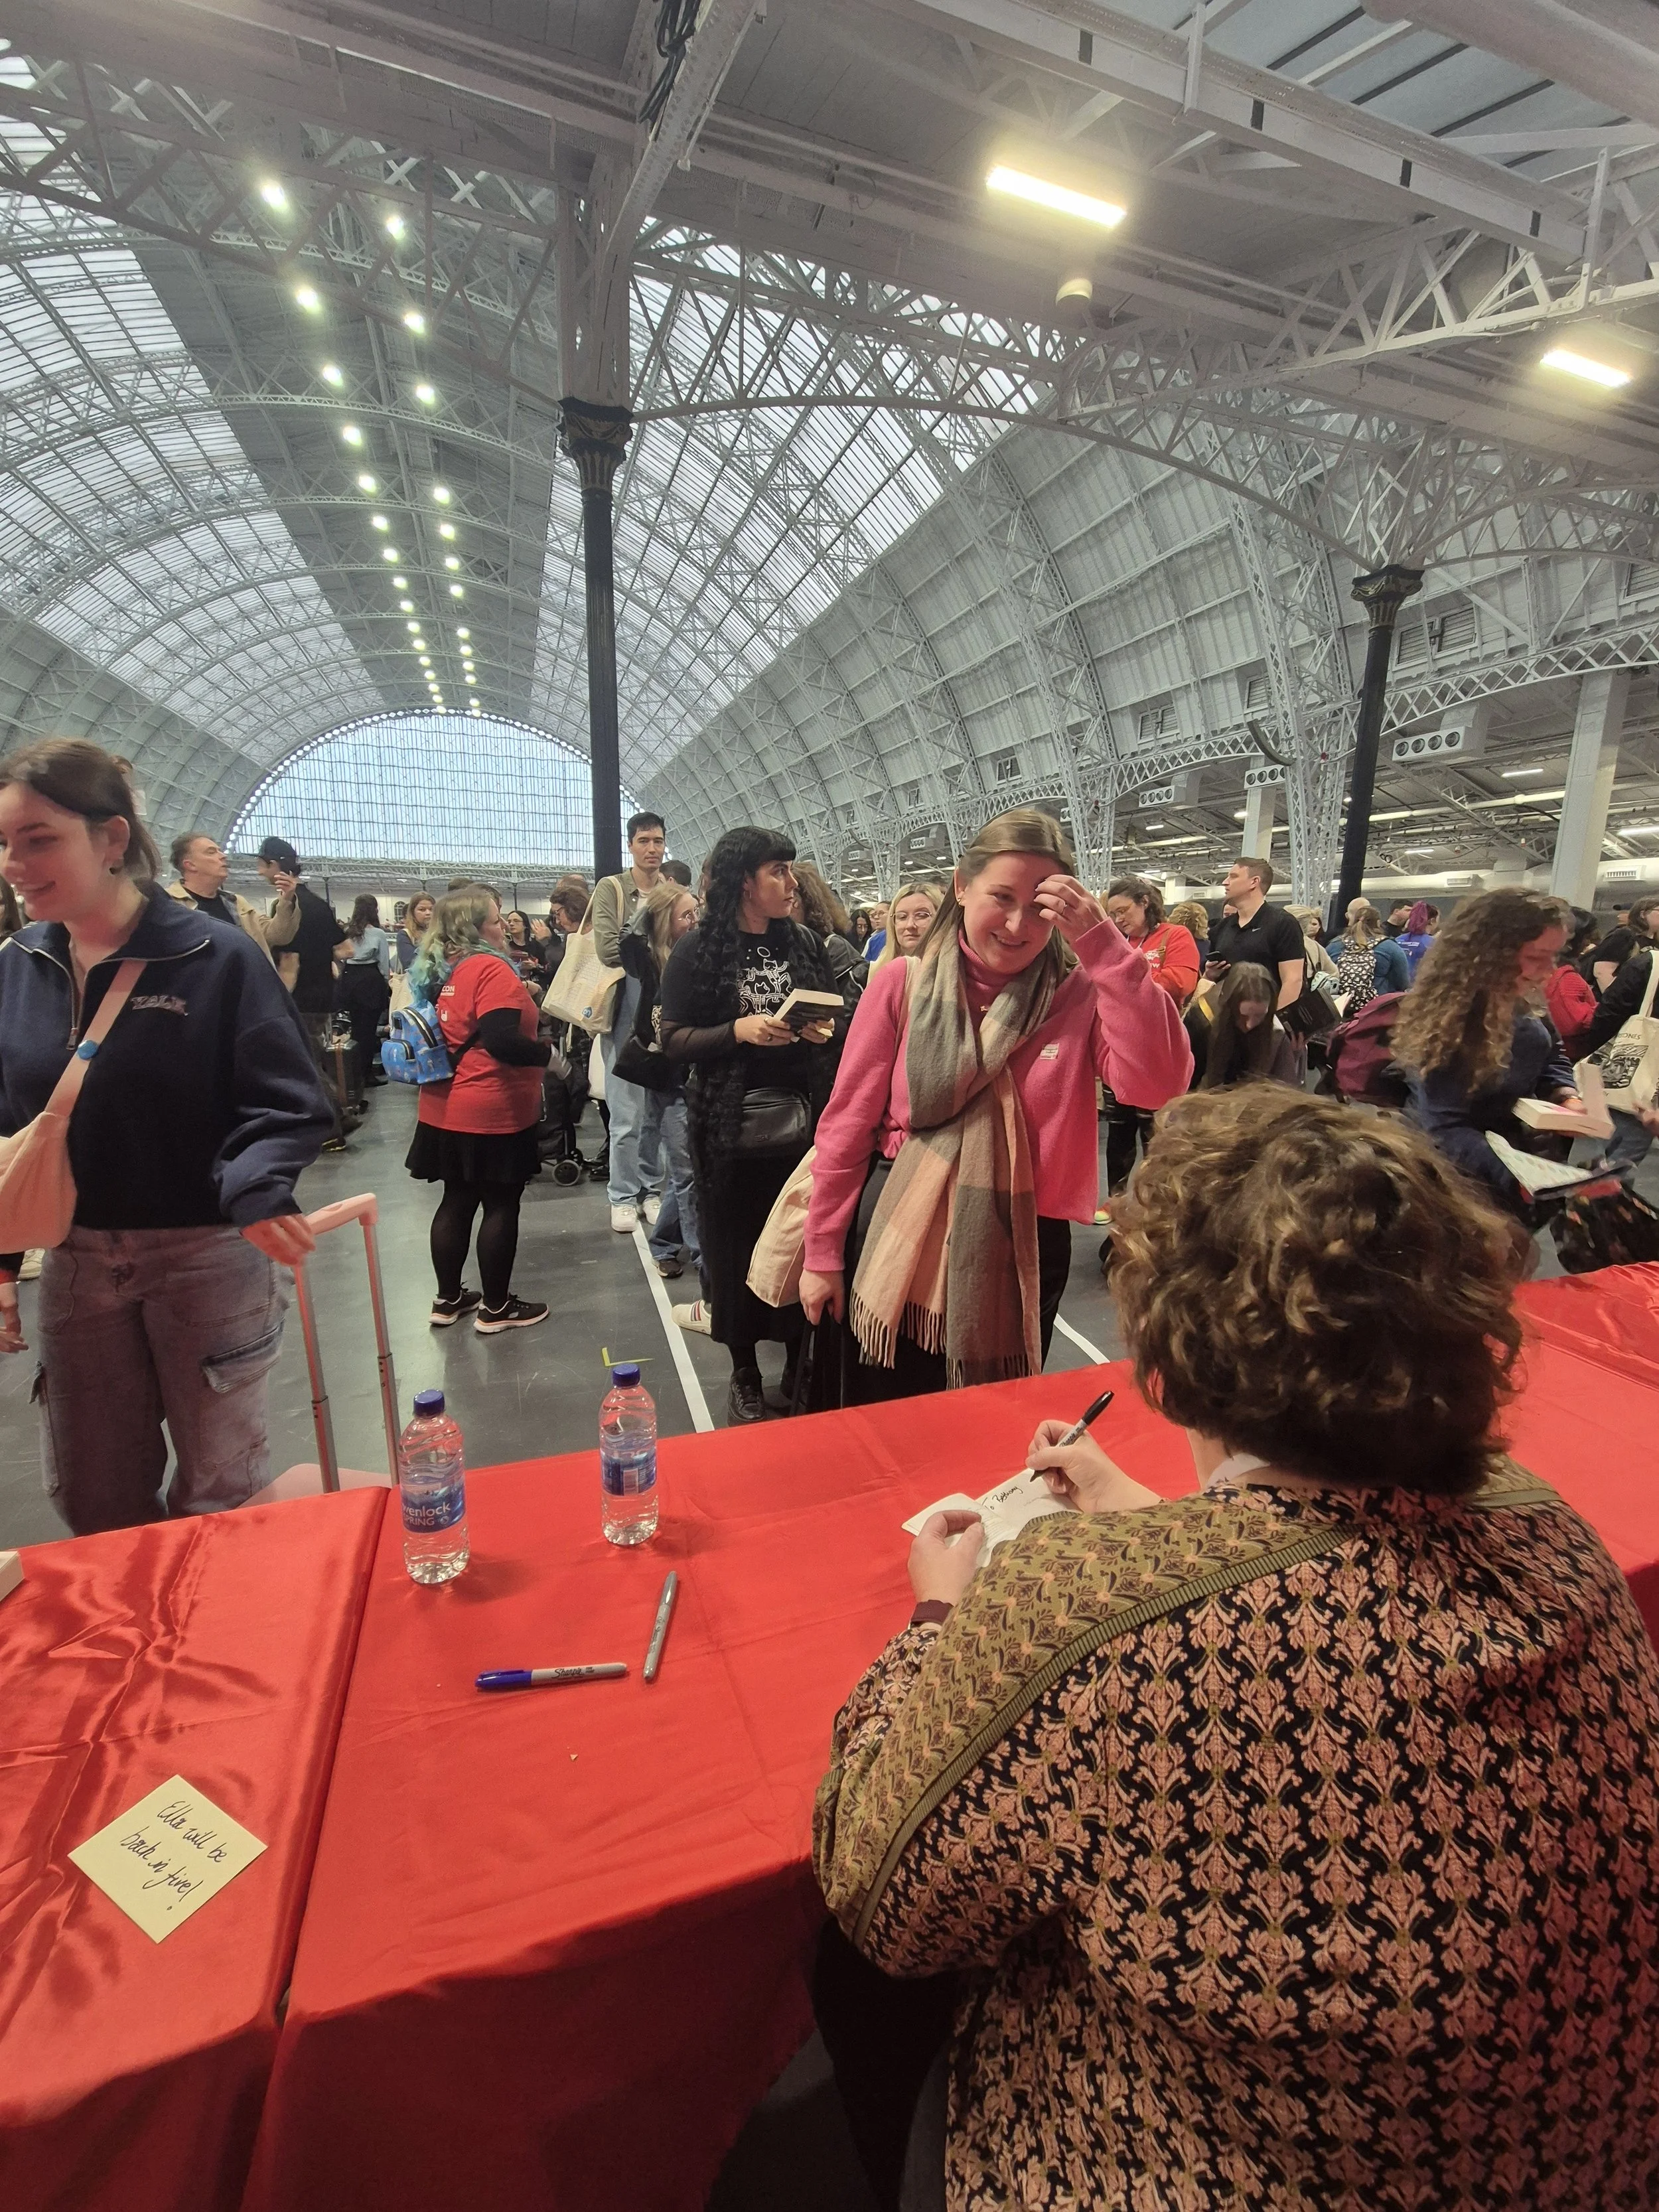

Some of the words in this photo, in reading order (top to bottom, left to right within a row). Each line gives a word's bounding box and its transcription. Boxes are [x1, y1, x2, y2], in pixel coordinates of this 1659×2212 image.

[981, 1497, 995, 1510] To
[119, 1826, 162, 1860] back
[147, 1858, 171, 1874] in
[157, 1801, 194, 1830] Ella
[182, 1827, 218, 1850] will
[206, 1842, 228, 1863] be
